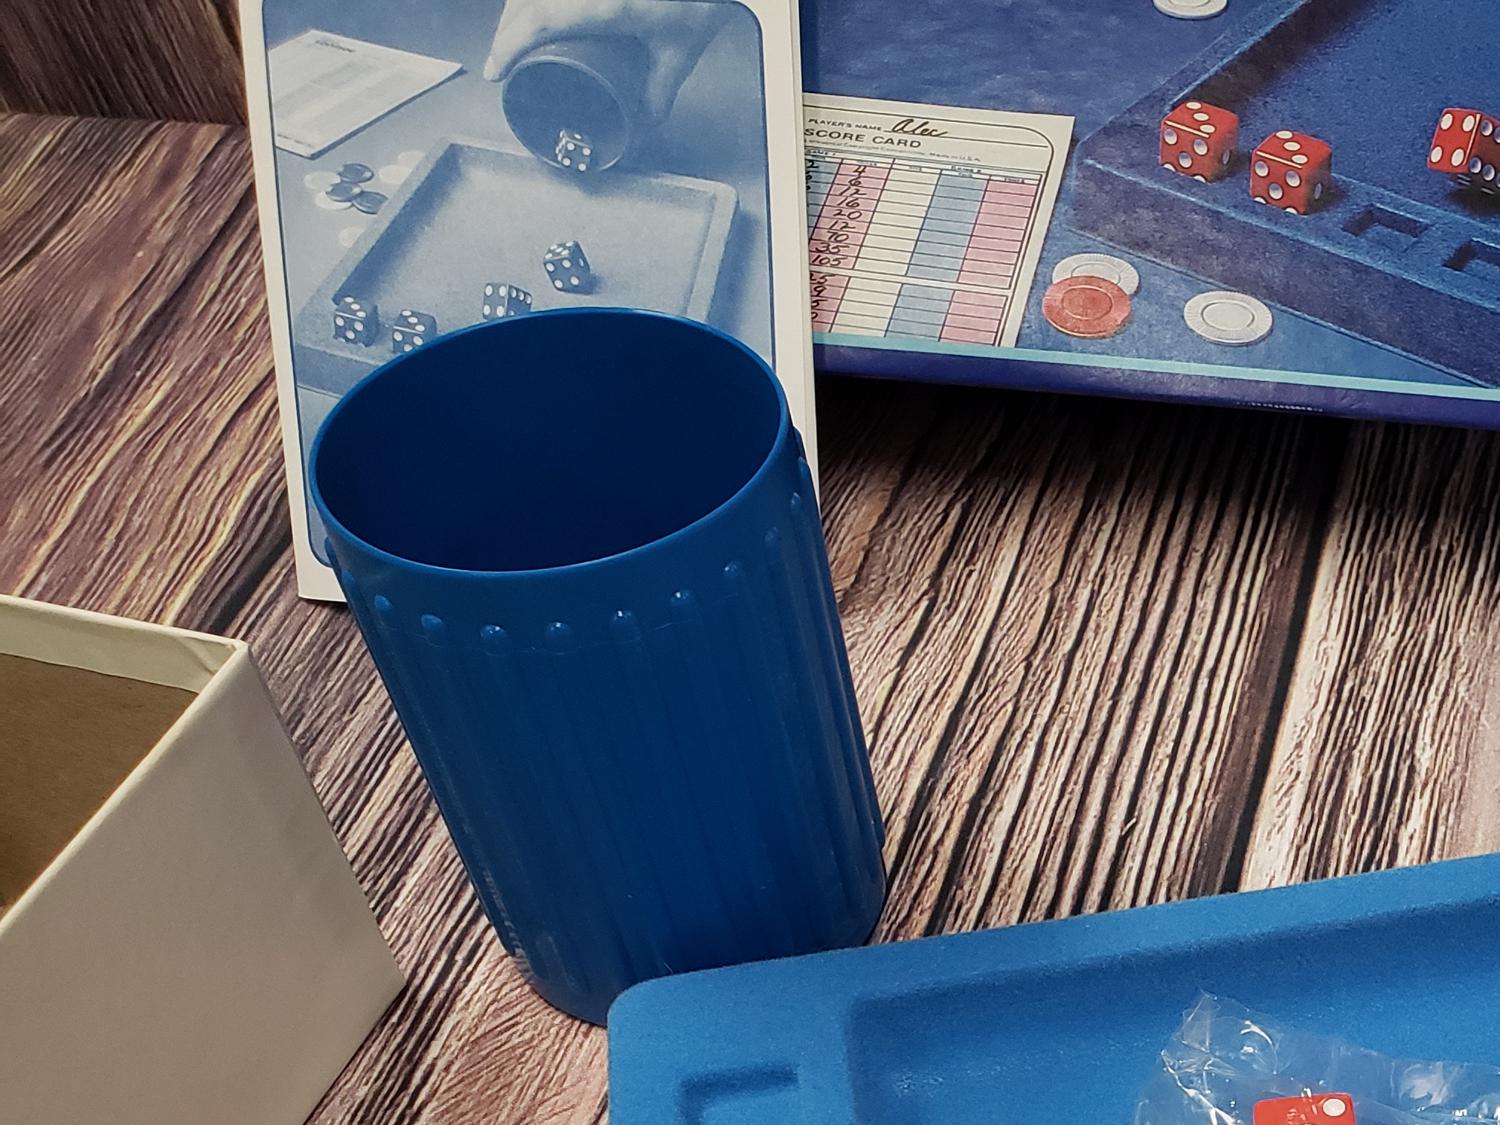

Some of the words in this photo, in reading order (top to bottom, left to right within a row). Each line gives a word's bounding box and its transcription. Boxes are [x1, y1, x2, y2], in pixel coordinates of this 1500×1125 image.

[807, 118, 852, 129] PLAYER'S
[855, 124, 882, 132] NAME
[804, 128, 866, 143] SCORE
[872, 135, 922, 149] CARD
[833, 209, 863, 220] 20
[826, 230, 849, 242] 70
[811, 254, 848, 267] 105
